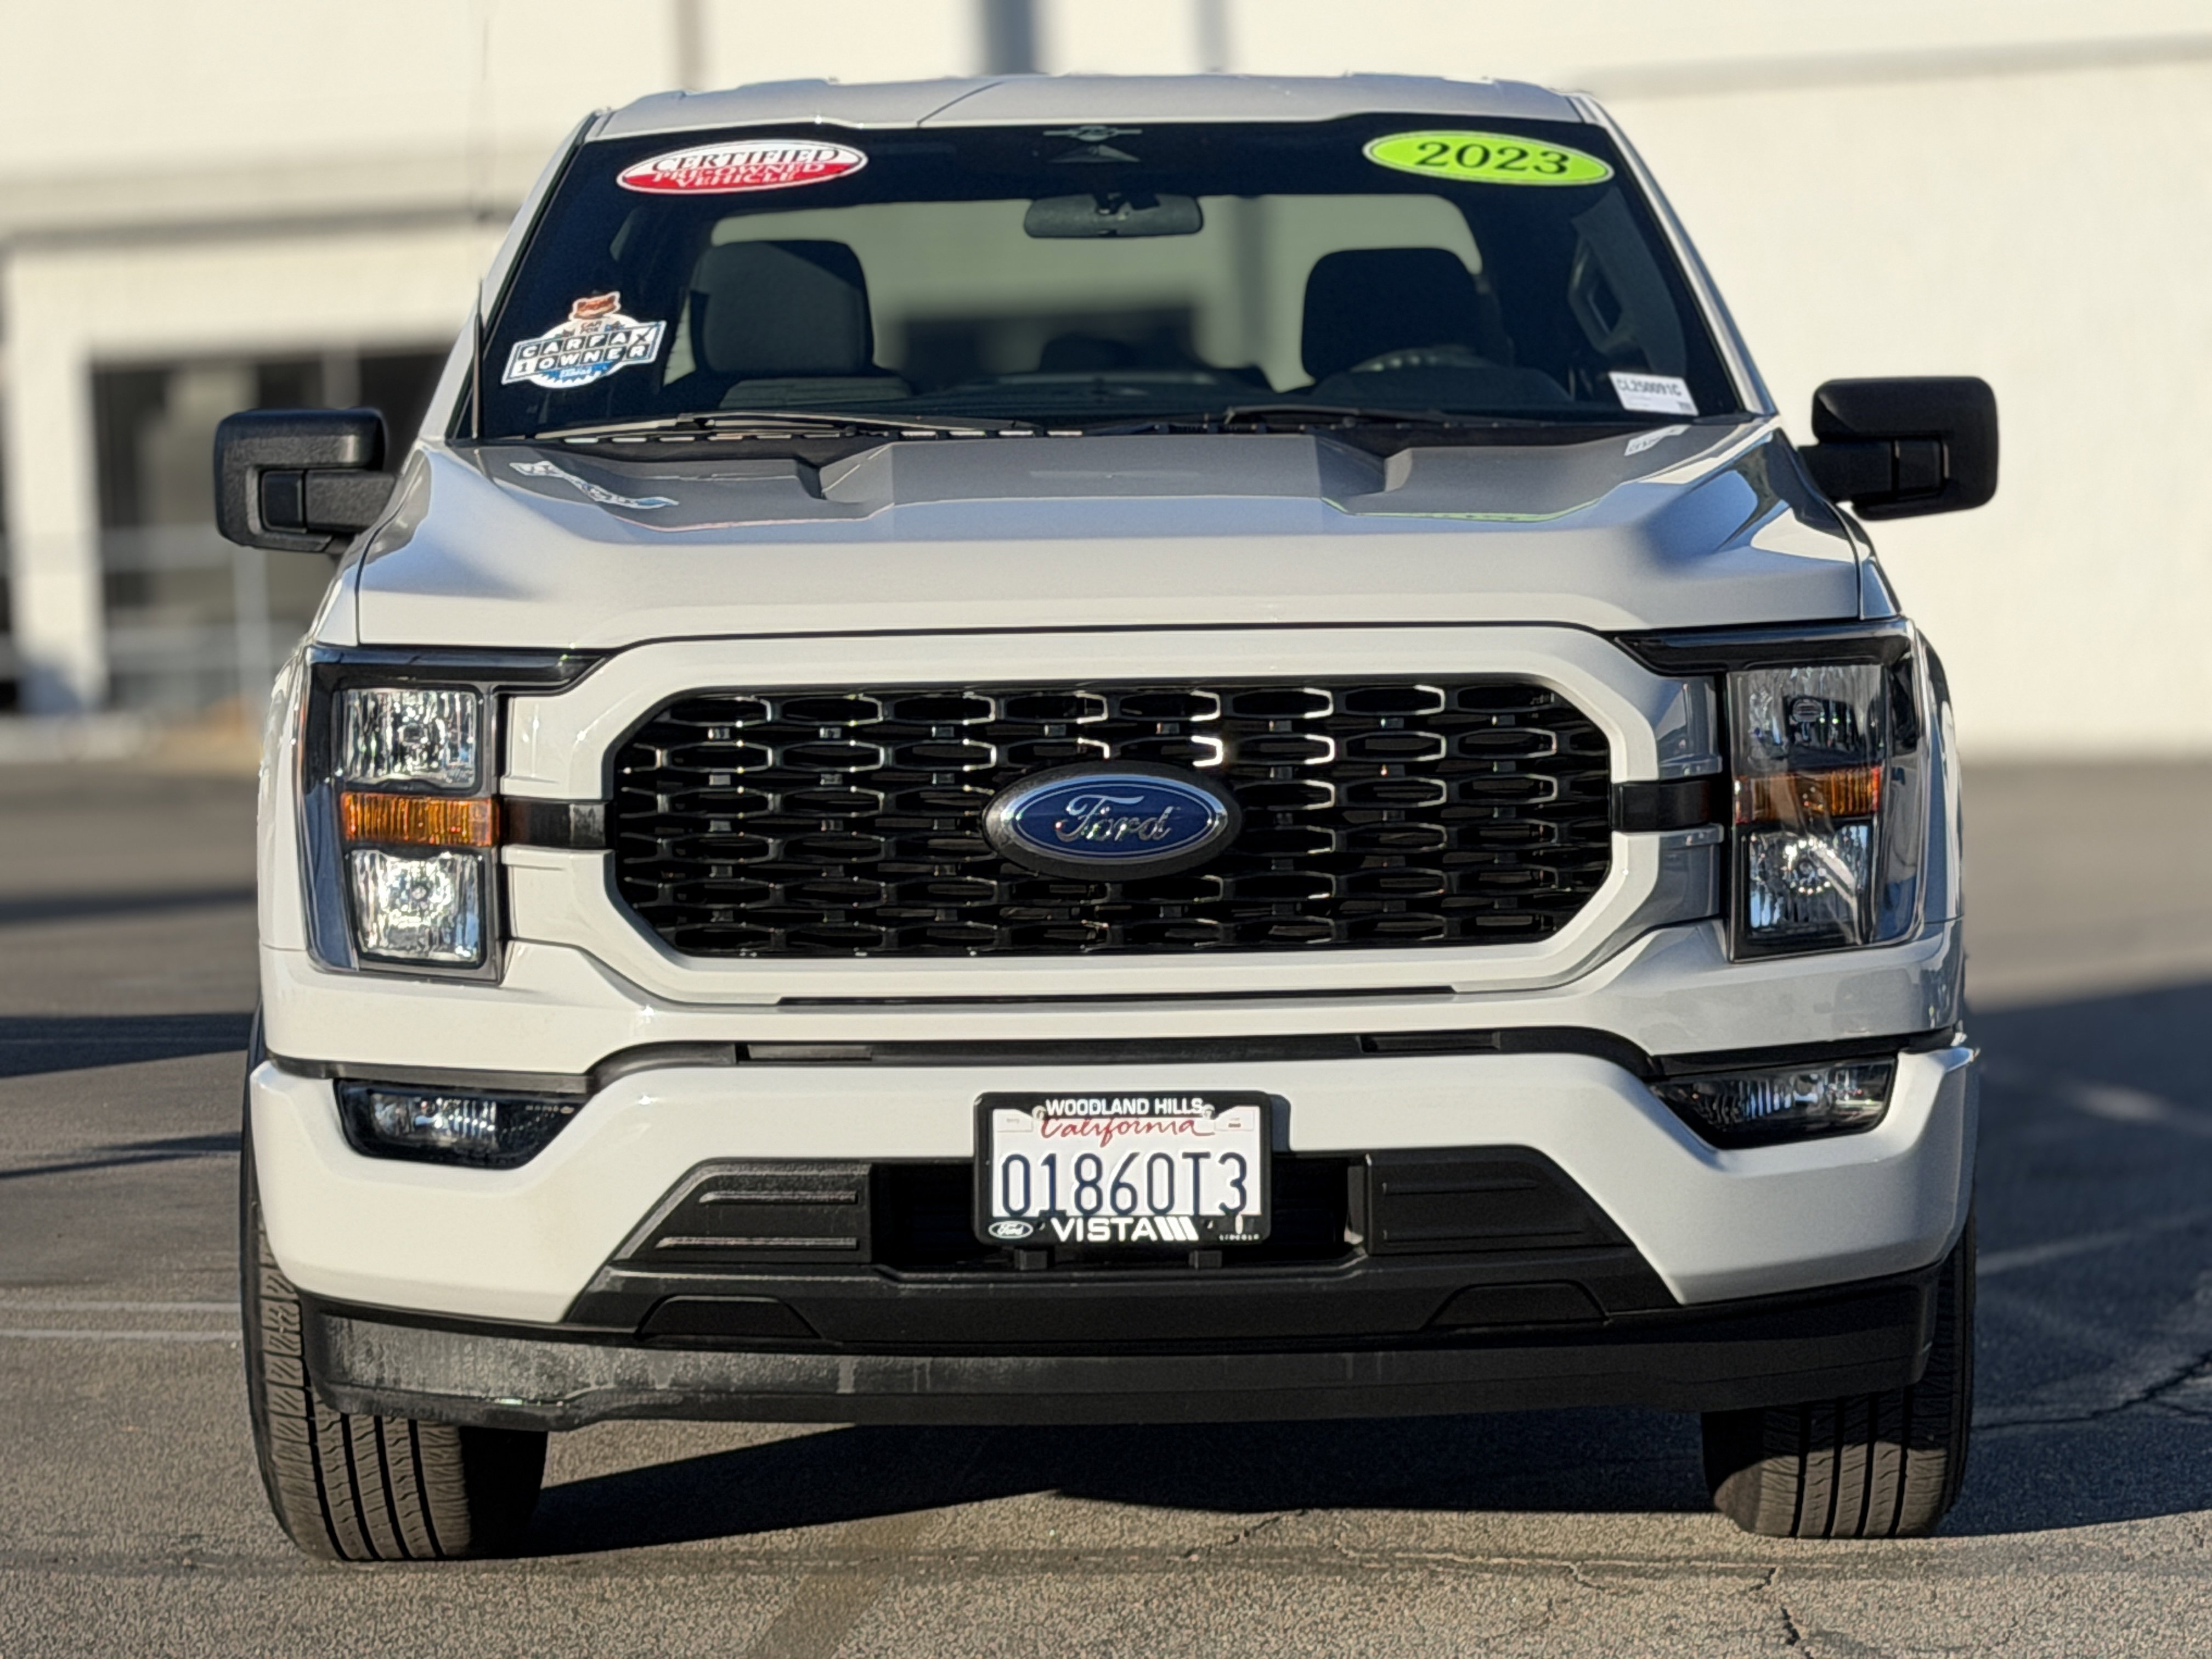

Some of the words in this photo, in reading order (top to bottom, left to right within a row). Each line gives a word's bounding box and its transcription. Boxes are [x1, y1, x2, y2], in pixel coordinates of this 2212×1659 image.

[652, 149, 840, 171] CERTIFIED
[1413, 141, 1570, 174] 2023
[653, 162, 824, 183] PRE-OWNED
[676, 173, 797, 188] VEHICLE
[522, 325, 654, 358] CARFAX
[538, 346, 646, 370] OWNER
[1054, 794, 1181, 843] Ford
[1045, 1098, 1149, 1116] WOODLAND
[1154, 1098, 1203, 1115] HILLS
[1041, 1117, 1215, 1148] California
[1001, 1152, 1247, 1216] 01860T3
[1051, 1217, 1158, 1242] VISTA
